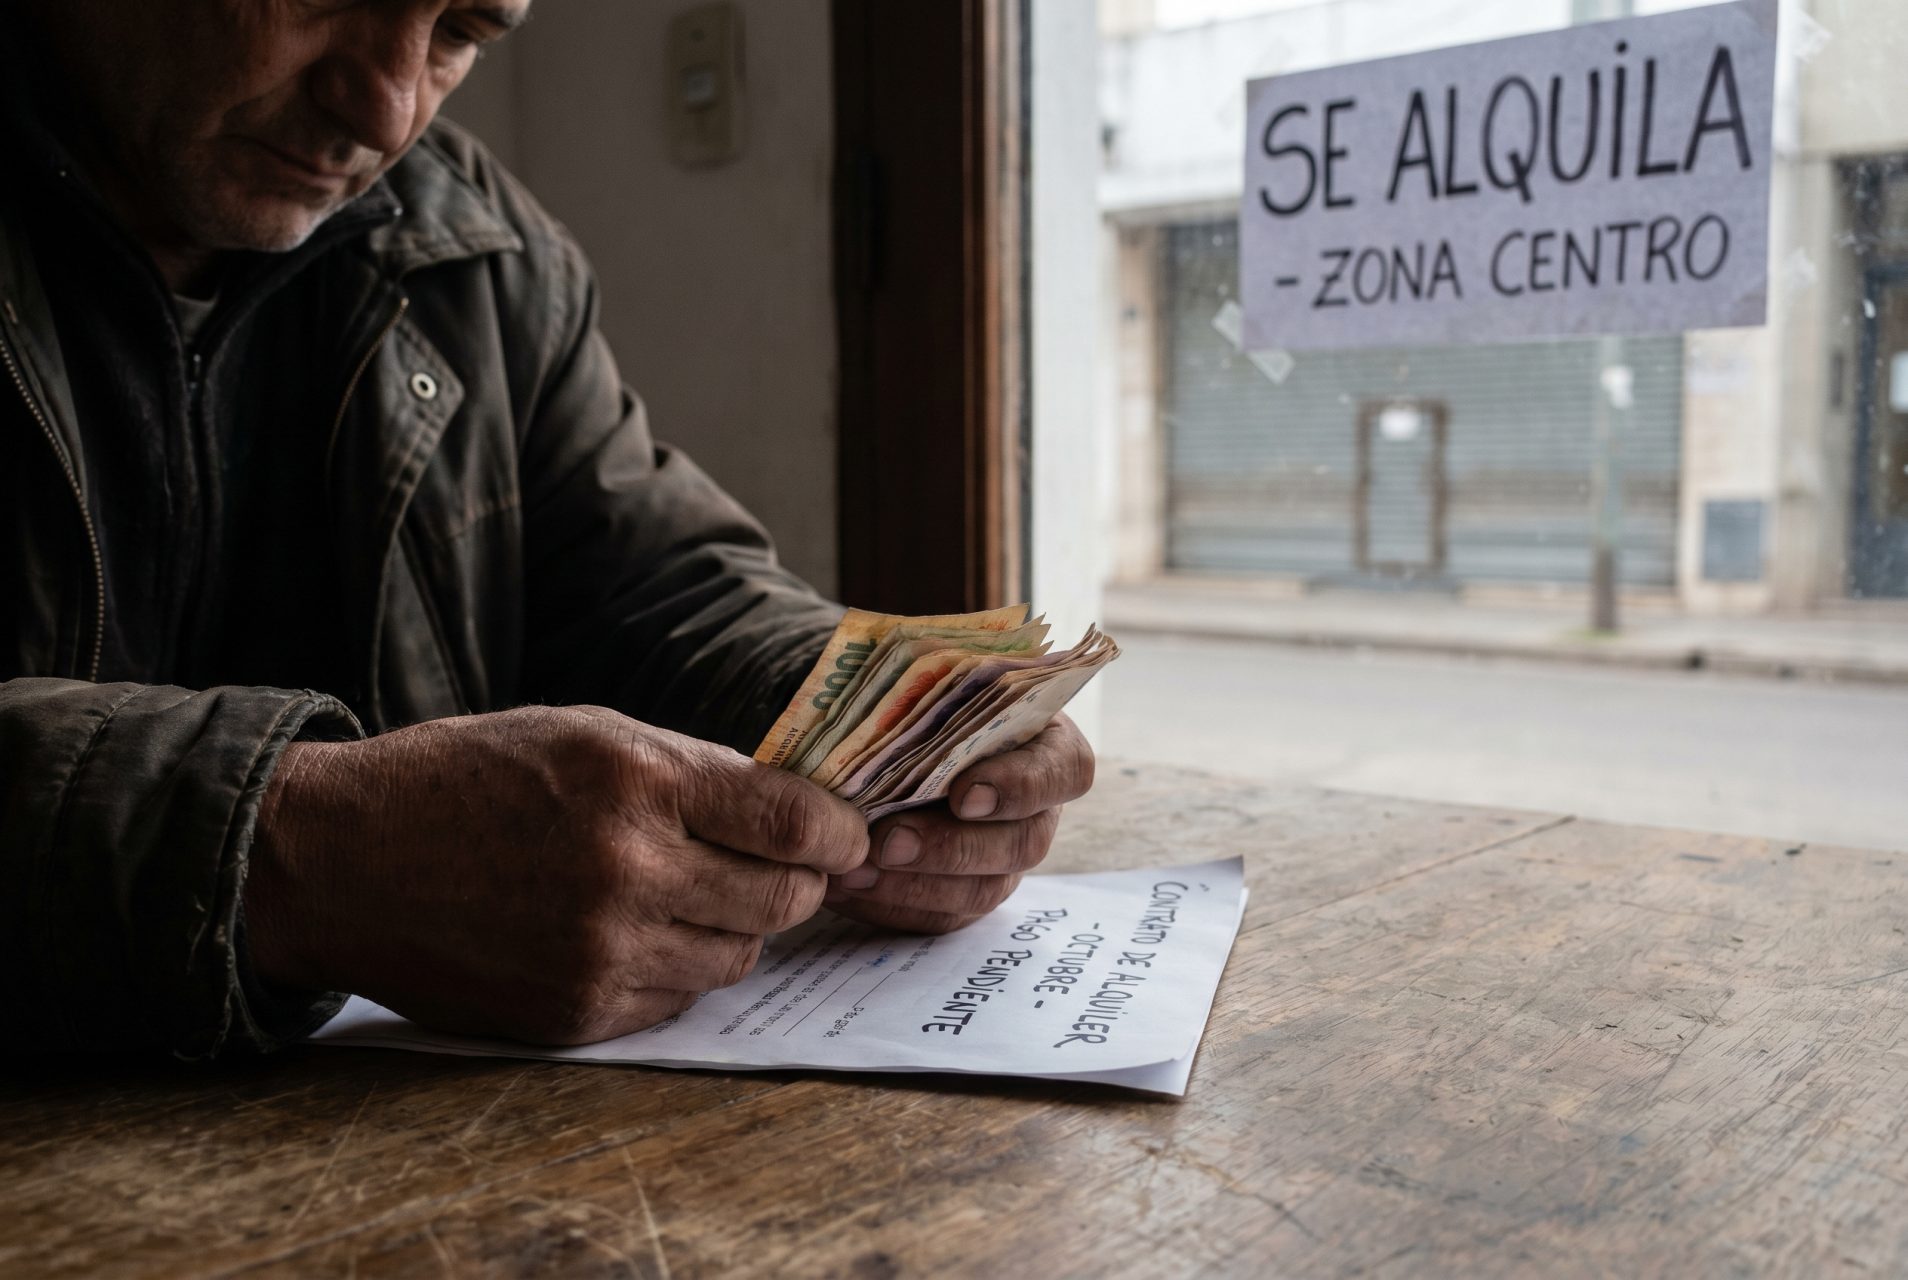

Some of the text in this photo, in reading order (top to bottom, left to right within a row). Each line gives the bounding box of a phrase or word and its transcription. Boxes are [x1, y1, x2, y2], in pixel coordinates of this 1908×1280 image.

[1259, 98, 1356, 217] SE
[1311, 240, 1463, 310] ZONA
[1490, 213, 1731, 297] CENTRO
[812, 638, 877, 710] 1000
[1010, 908, 1069, 942] PAGO
[1130, 880, 1189, 945] CONTRATO
[1032, 933, 1105, 996] OCTUBRE
[1116, 951, 1157, 969] DE
